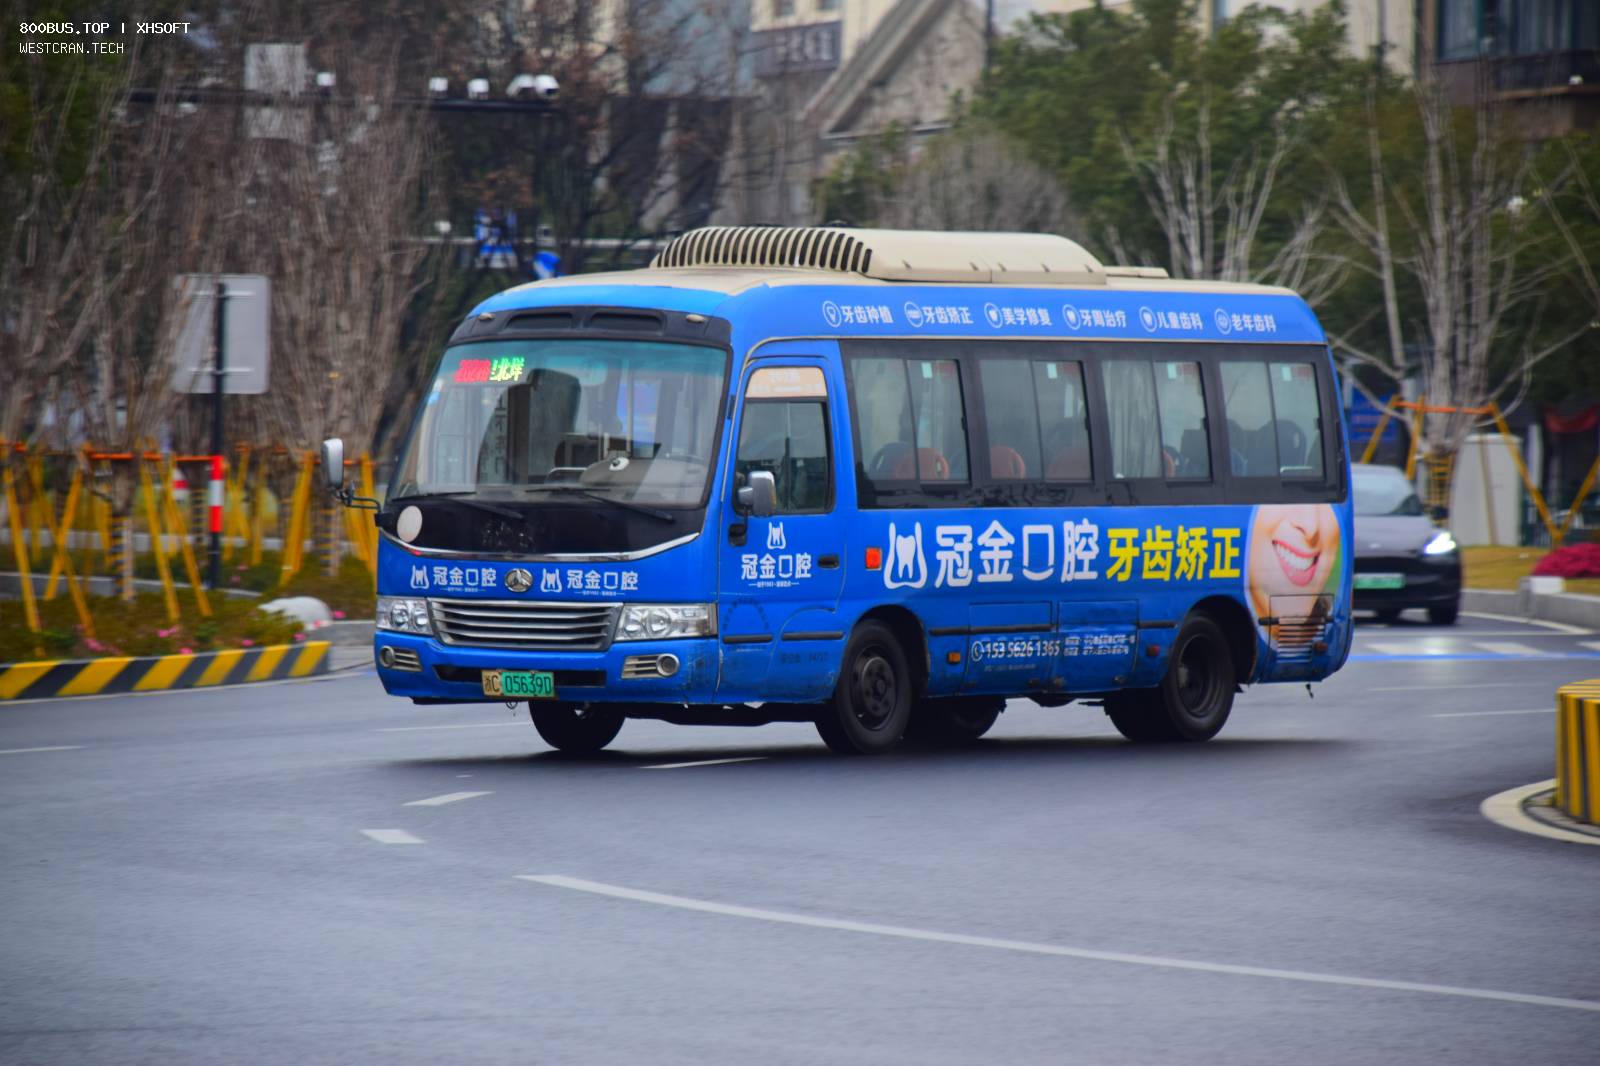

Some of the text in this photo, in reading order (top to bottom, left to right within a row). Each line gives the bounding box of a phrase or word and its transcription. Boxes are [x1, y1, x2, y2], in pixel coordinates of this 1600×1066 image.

[841, 305, 1277, 333] 牙齿种植 牙齿矫正 美学修复 牙周治疗 儿童齿科 老年齿科
[934, 517, 1241, 588] 冠金口腔 牙齿矫正
[432, 566, 497, 587] 冠金口腔
[741, 552, 812, 580] 冠金口腔
[567, 569, 639, 591] 冠金口腔
[985, 641, 1005, 658] 153
[1007, 640, 1034, 658] 5626
